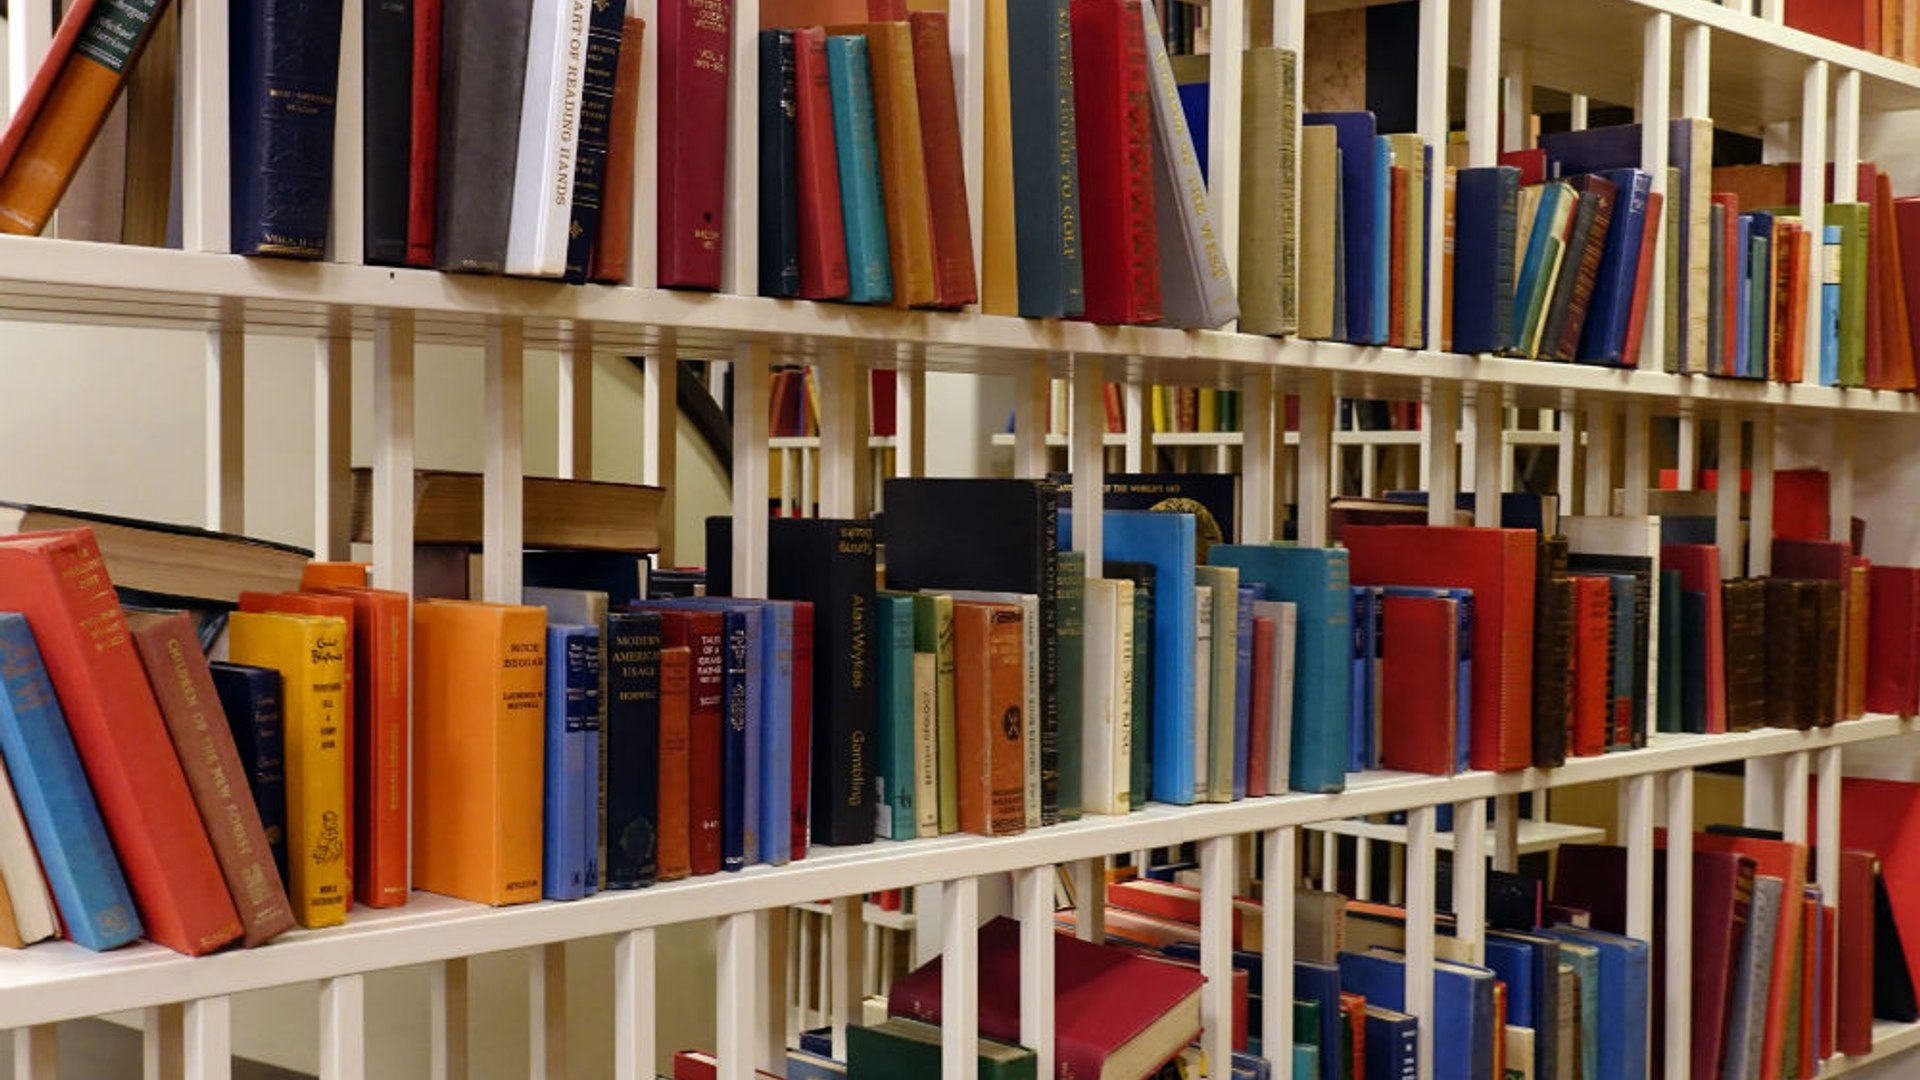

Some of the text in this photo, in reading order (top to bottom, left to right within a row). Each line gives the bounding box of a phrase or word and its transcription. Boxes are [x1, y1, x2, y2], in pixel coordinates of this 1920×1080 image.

[555, 1, 585, 206] ART OF READING HANDS
[1062, 205, 1078, 260] GOLF
[849, 594, 865, 631] Alan
[503, 658, 545, 669] BEGGAR
[616, 635, 661, 646] MODERN
[167, 638, 199, 707] CHILDREN
[201, 736, 219, 764] THE
[211, 764, 233, 800] NEW
[223, 803, 254, 857] FOREST
[848, 730, 866, 806] Gambling
